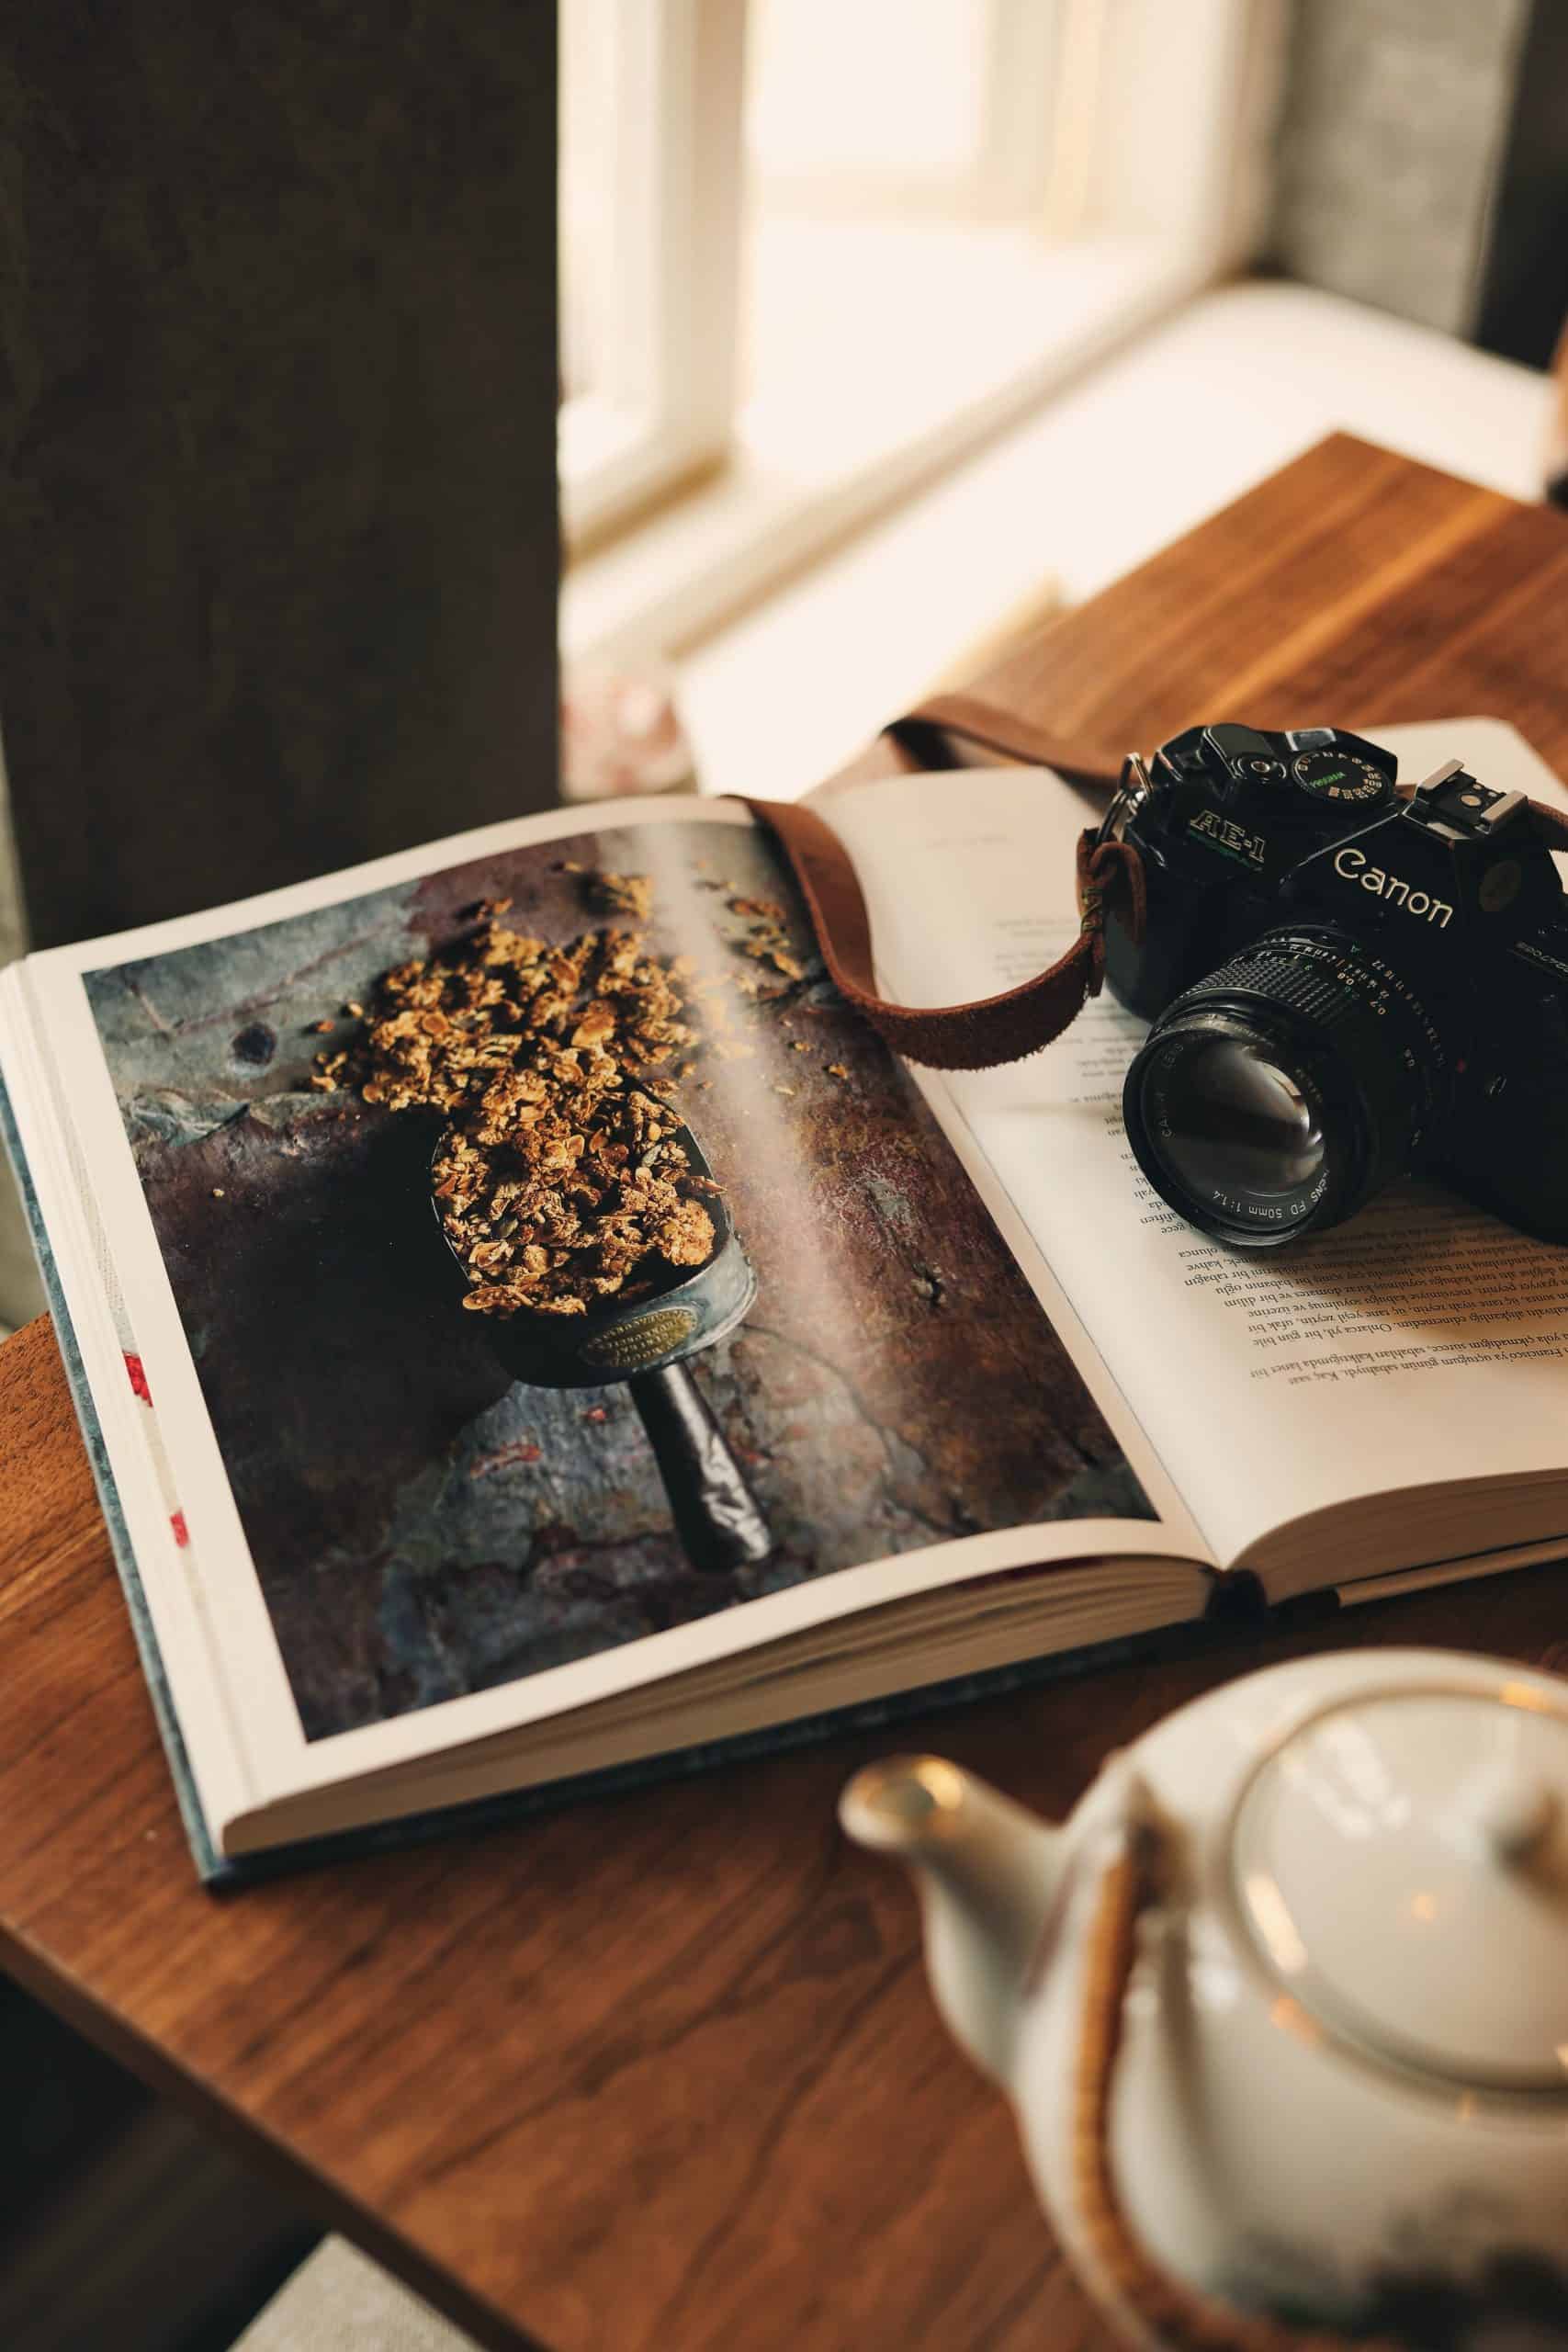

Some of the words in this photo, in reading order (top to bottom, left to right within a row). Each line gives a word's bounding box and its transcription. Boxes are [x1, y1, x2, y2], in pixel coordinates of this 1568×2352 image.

[1190, 809, 1265, 864] AE-1
[1334, 847, 1454, 929] Canon
[1248, 1204, 1282, 1219] 50mm
[1291, 1200, 1306, 1215] FD
[1185, 1260, 1223, 1273] kahve
[1185, 1272, 1228, 1285] tabağın
[1231, 1271, 1249, 1282] bir
[1215, 1282, 1242, 1297] oğlu
[1245, 1280, 1293, 1291] babanın
[1258, 1294, 1278, 1306] bir
[1279, 1292, 1292, 1301] ve
[1224, 1297, 1256, 1312] dilim
[1338, 1311, 1361, 1324] yeşil
[1366, 1309, 1390, 1318] tane
[1248, 1323, 1267, 1334] bir
[1268, 1319, 1293, 1332] ufak
[1345, 1324, 1392, 1334] Onlarca
[1278, 1329, 1301, 1344] gün
[1303, 1330, 1323, 1342] bir
[1251, 1337, 1277, 1349] bile
[1403, 1357, 1438, 1373] günün
[1250, 1367, 1270, 1379] bir
